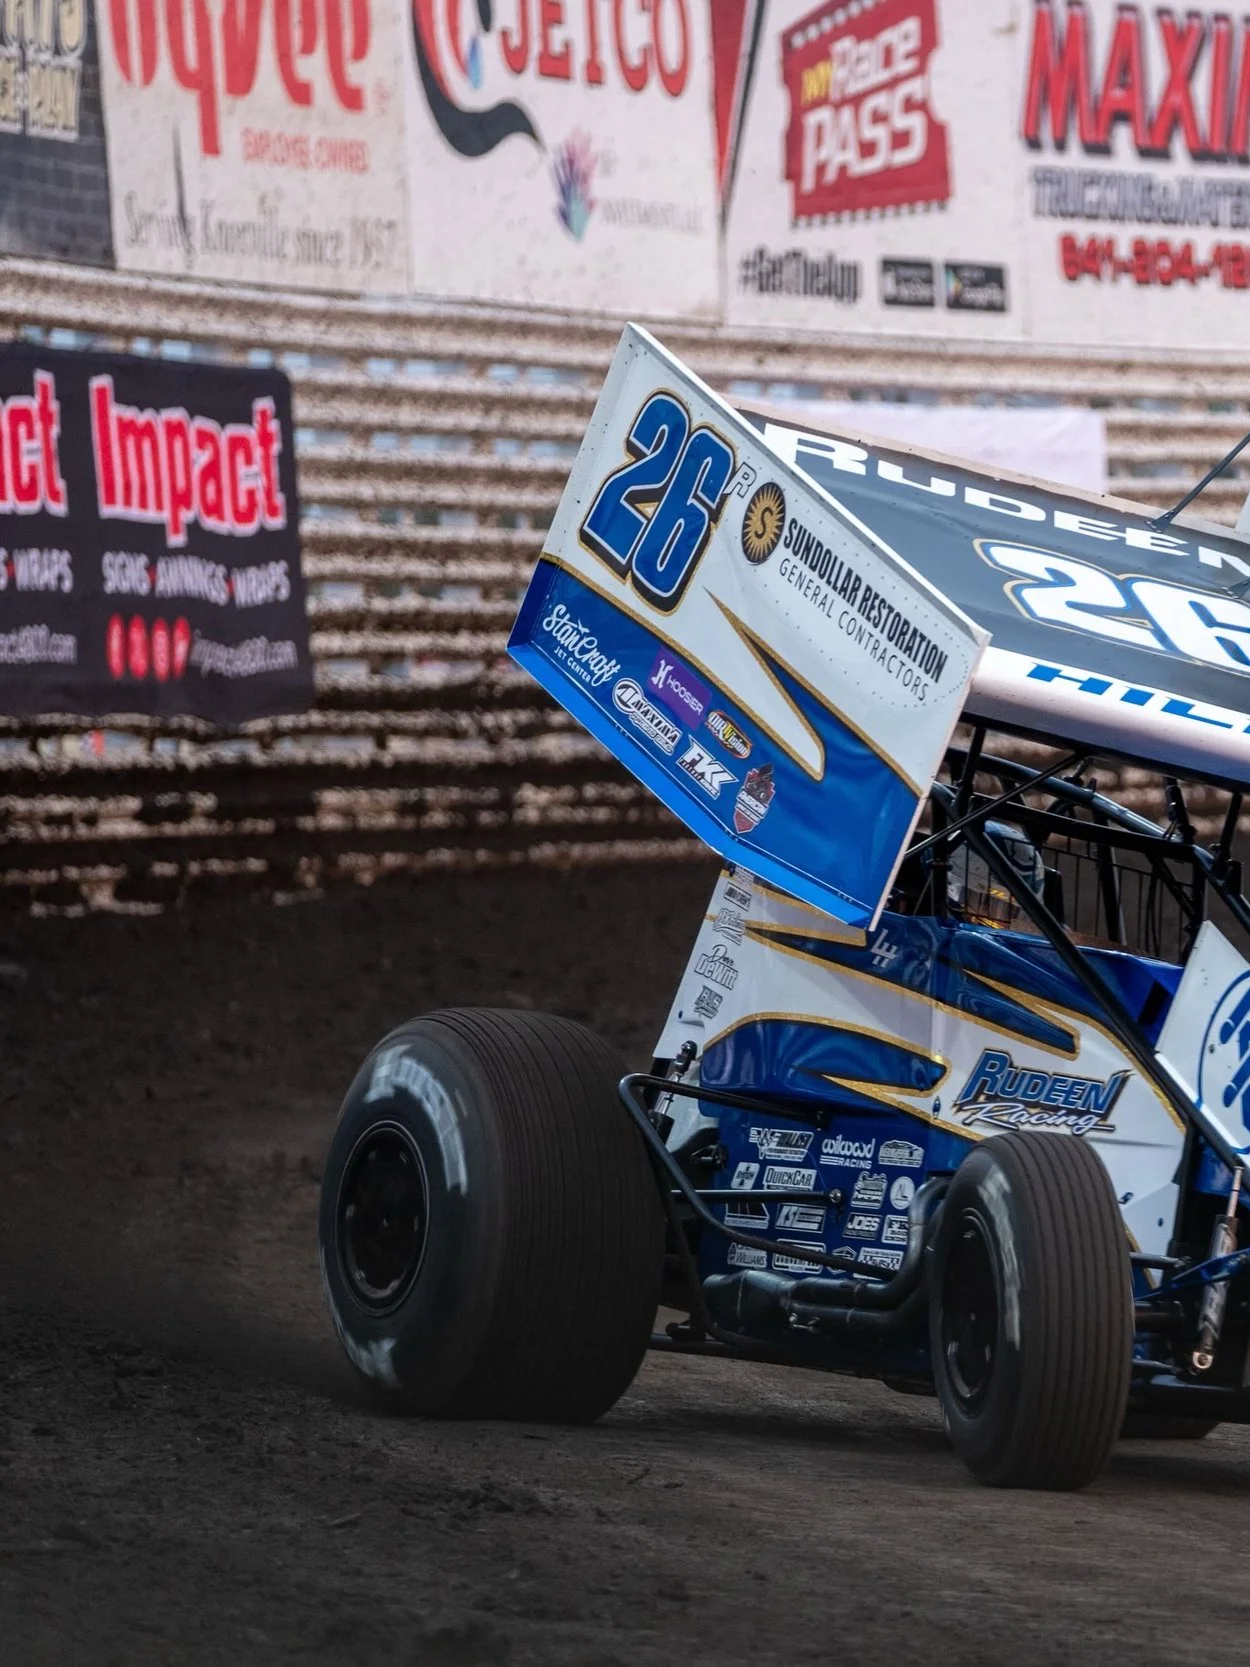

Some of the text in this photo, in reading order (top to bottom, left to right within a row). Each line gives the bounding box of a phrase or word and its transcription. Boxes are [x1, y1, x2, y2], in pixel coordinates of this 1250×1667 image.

[800, 75, 929, 194] PASS
[88, 374, 287, 549] Impact
[579, 389, 737, 615] 26
[102, 551, 150, 595] SIGNS
[231, 560, 290, 608] WRAPS
[784, 518, 949, 683] SUNDOLLAR RESTORATION
[542, 604, 621, 687] StanCraft
[779, 558, 929, 701] GENERAL CONTRACTORS
[554, 645, 592, 684] JET CENTER
[667, 676, 704, 716] HOOSIER
[954, 1047, 1135, 1115] RUDEEN
[822, 1134, 876, 1159] wilwood
[962, 1102, 1116, 1136] Racing
[837, 1157, 873, 1170] RACING
[847, 1215, 880, 1232] JOES
